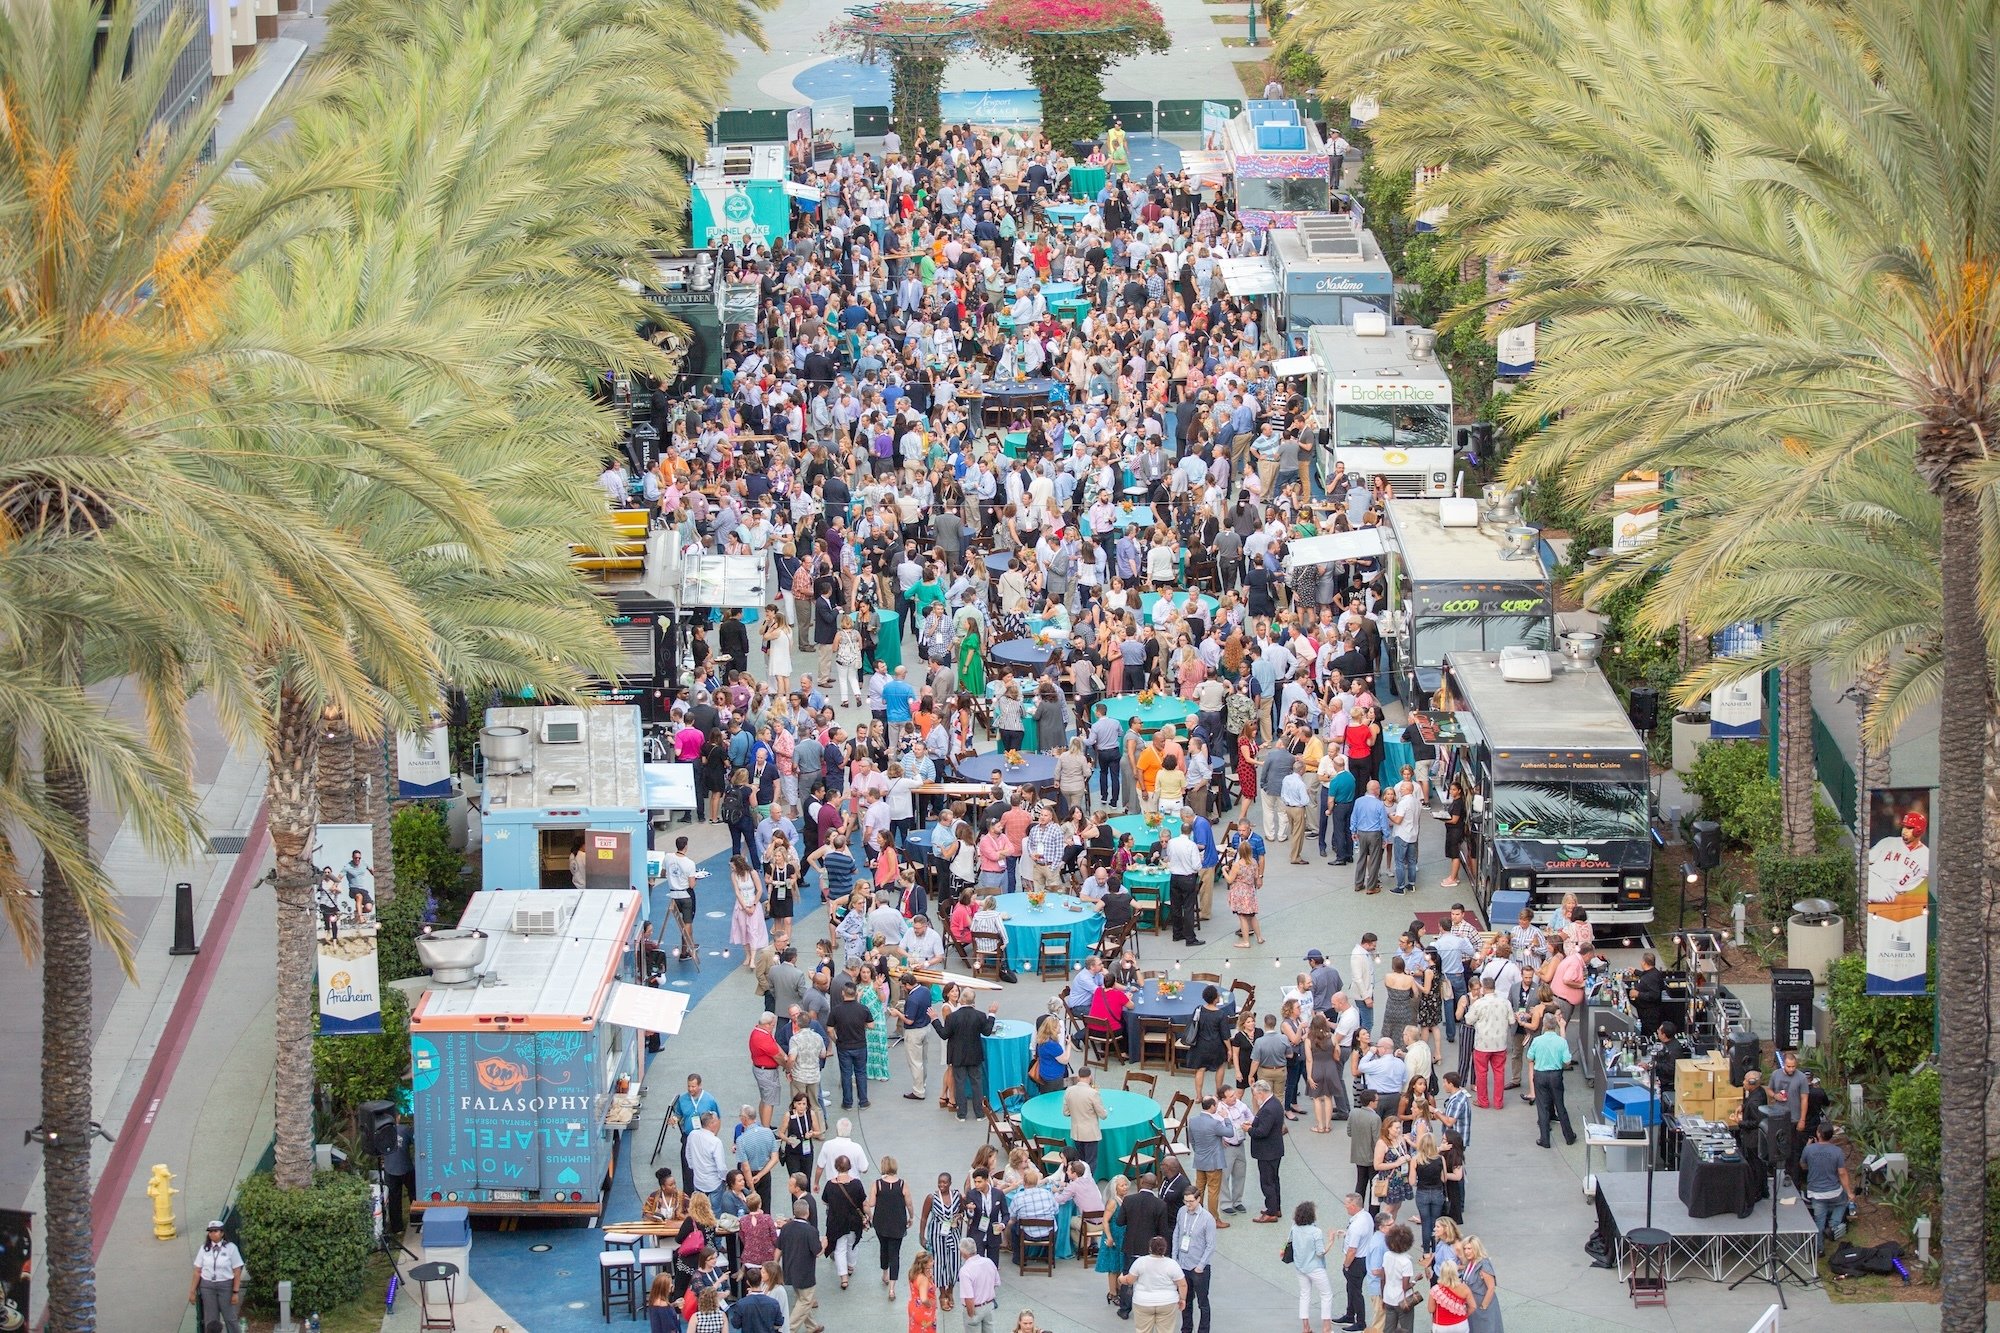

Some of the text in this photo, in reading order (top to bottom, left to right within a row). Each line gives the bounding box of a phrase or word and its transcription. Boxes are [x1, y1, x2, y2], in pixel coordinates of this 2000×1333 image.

[707, 226, 769, 236] FUNNEL CAKE
[645, 294, 711, 303] HALL CANTEEN
[1351, 385, 1434, 400] Broken Rice
[1442, 600, 1480, 612] GOOD
[1899, 874, 1910, 886] 5
[326, 985, 373, 1005] Anaheim
[1789, 1004, 1800, 1046] RECYCLE
[461, 1096, 590, 1112] FALASOPHY
[500, 1119, 530, 1127] MENTAL
[464, 1128, 588, 1149] FALAFEL
[442, 1157, 524, 1179] KNOW
